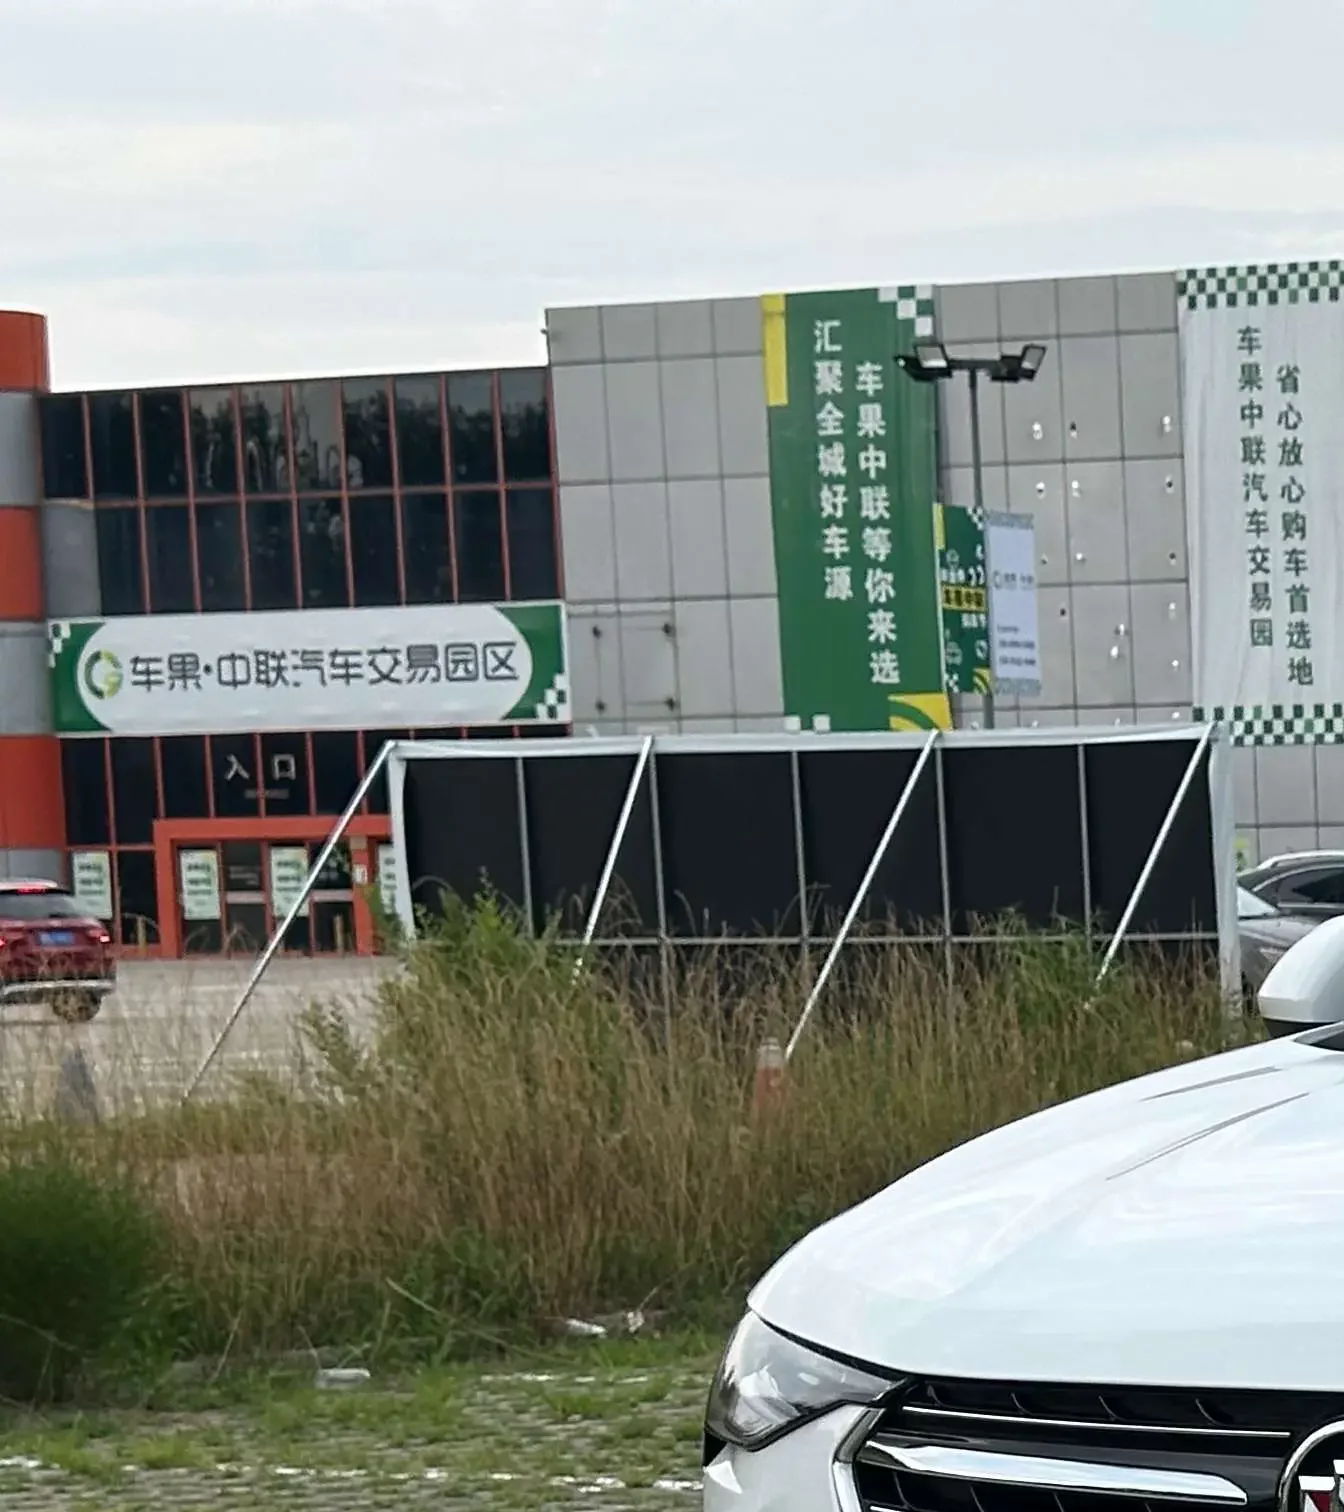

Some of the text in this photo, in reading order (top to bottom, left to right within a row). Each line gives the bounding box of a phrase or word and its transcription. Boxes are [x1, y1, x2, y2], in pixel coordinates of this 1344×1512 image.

[814, 320, 853, 600] 汇聚全城好车源
[856, 361, 900, 684] 车果中联等你来选
[1237, 325, 1273, 646] 车果中联汽车交易园
[1276, 364, 1313, 686] 省心放心购车首选地
[224, 753, 297, 782] 入口
